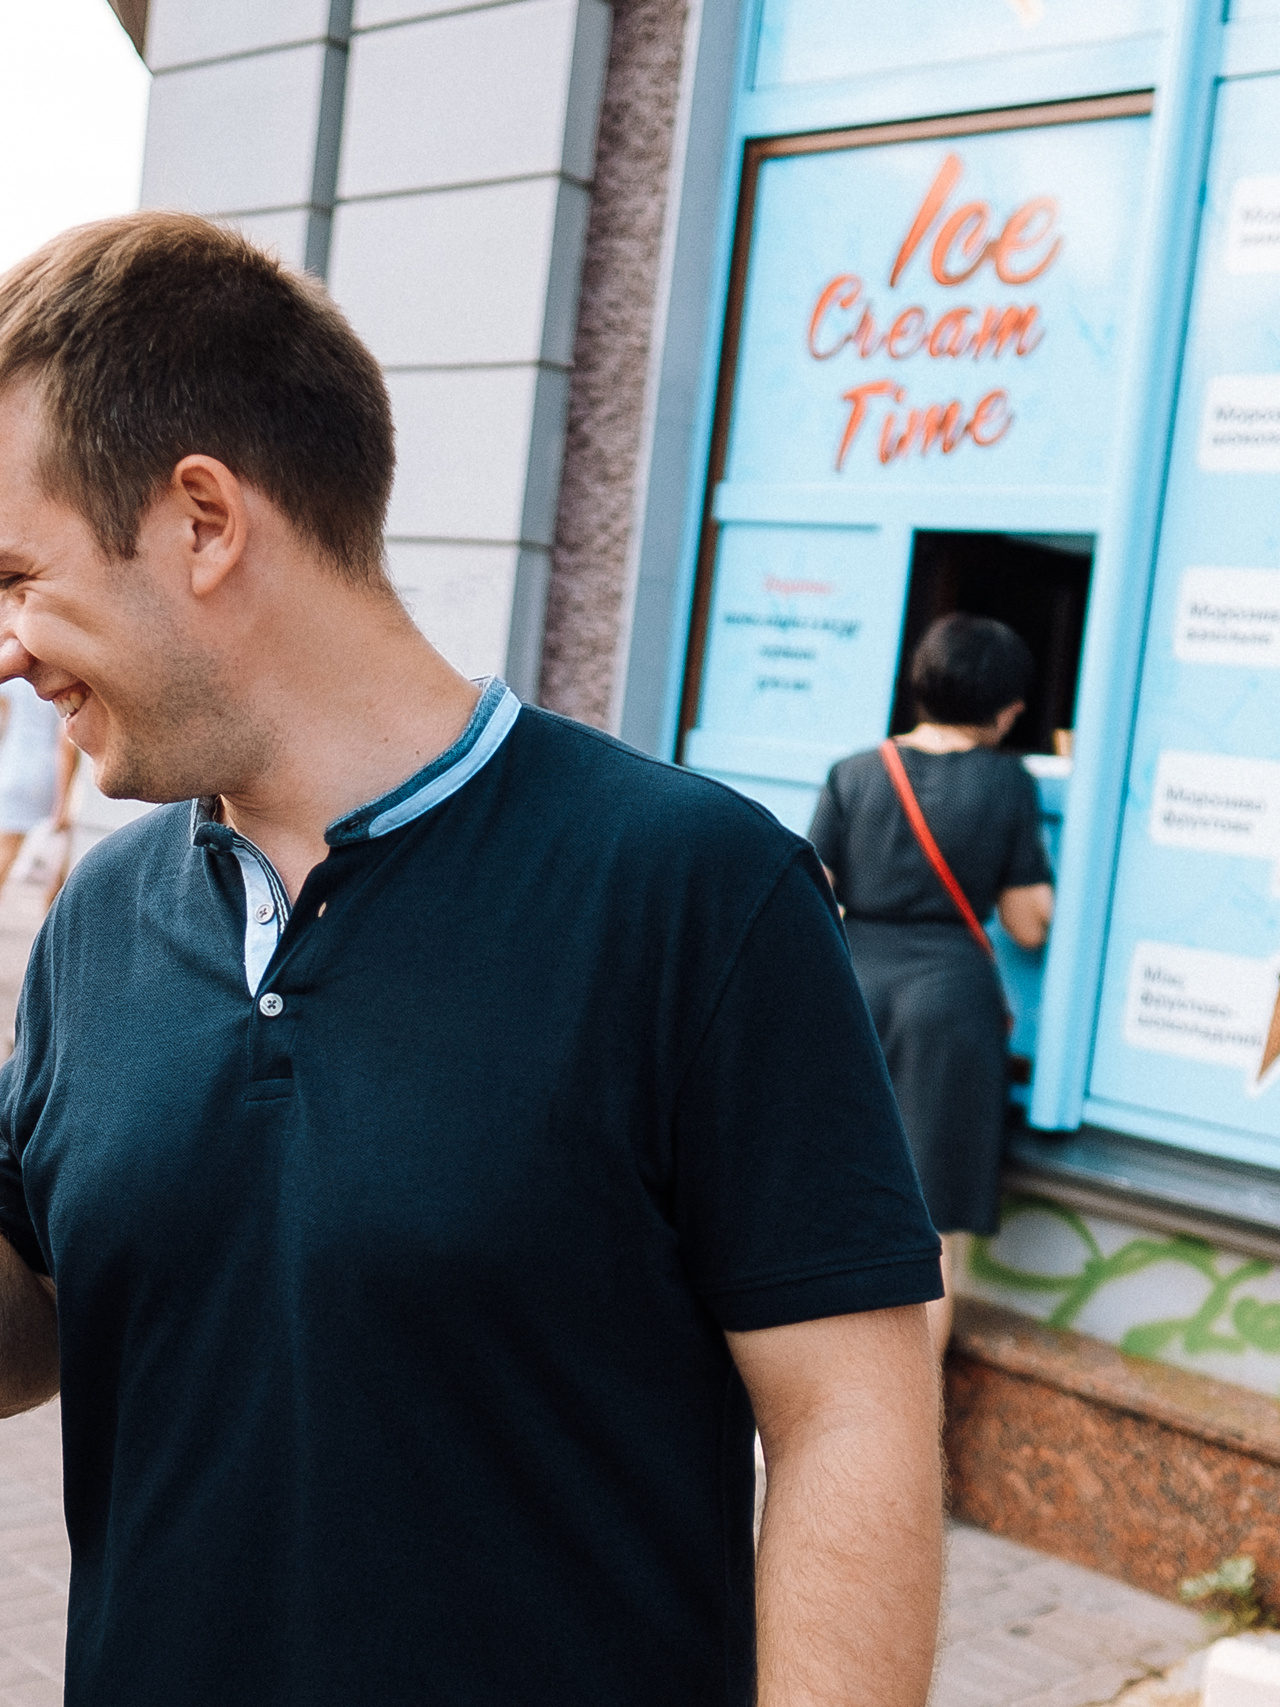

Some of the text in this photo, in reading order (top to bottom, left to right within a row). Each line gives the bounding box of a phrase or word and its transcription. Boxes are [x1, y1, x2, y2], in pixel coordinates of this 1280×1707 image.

[890, 152, 1062, 288] Ice
[808, 273, 1044, 362] Cream
[835, 379, 1013, 472] Time
